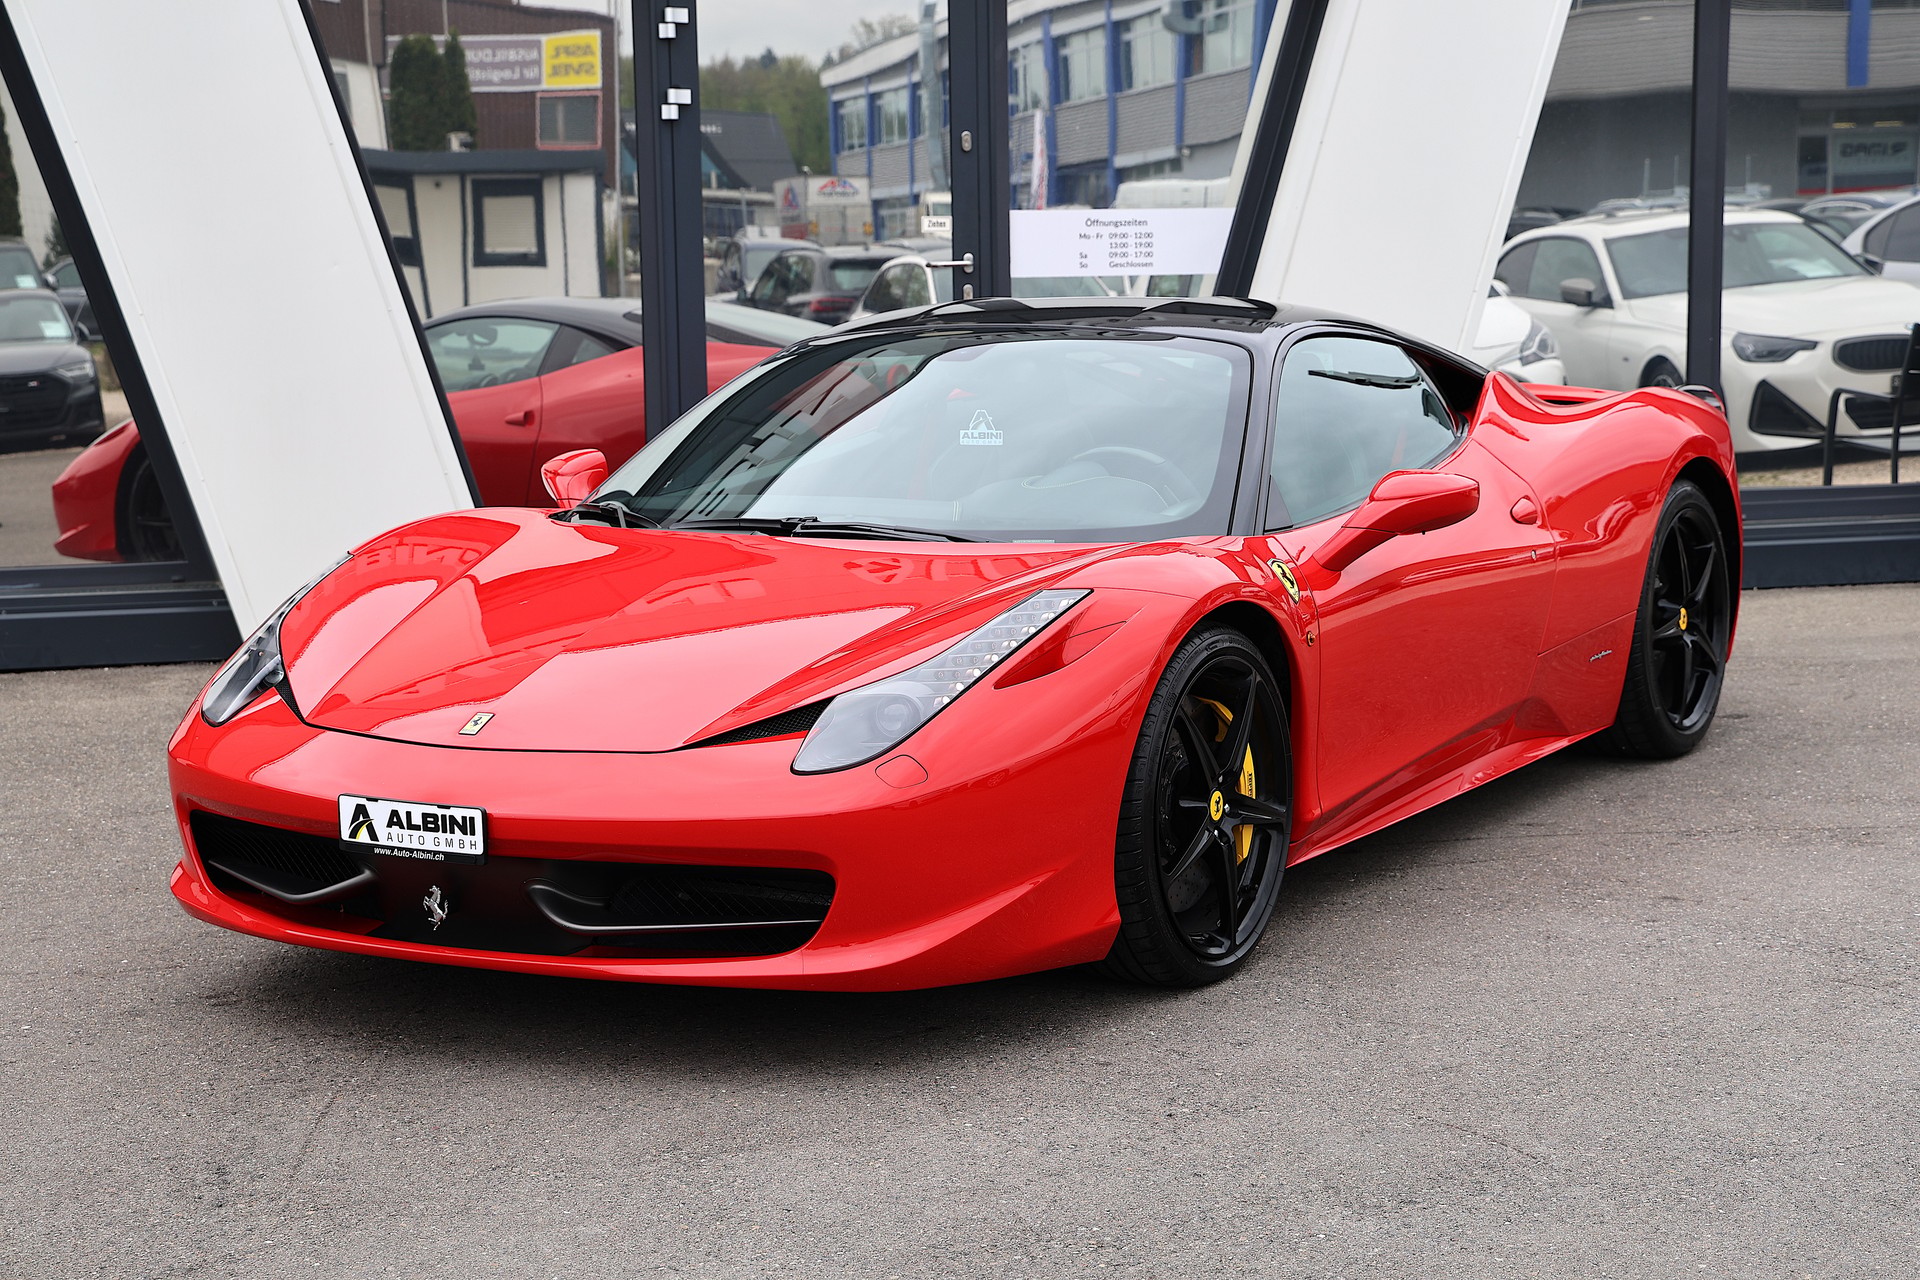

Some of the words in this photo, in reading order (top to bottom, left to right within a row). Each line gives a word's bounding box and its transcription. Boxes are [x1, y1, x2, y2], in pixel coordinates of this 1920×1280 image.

[1085, 218, 1148, 228] Öffnungszeiten
[961, 432, 1002, 440] ALBINI
[386, 809, 476, 837] ALBINI
[386, 832, 425, 846] AUTO
[433, 837, 477, 850] GMBH
[373, 847, 445, 861] www.Auto-Albini.ch
